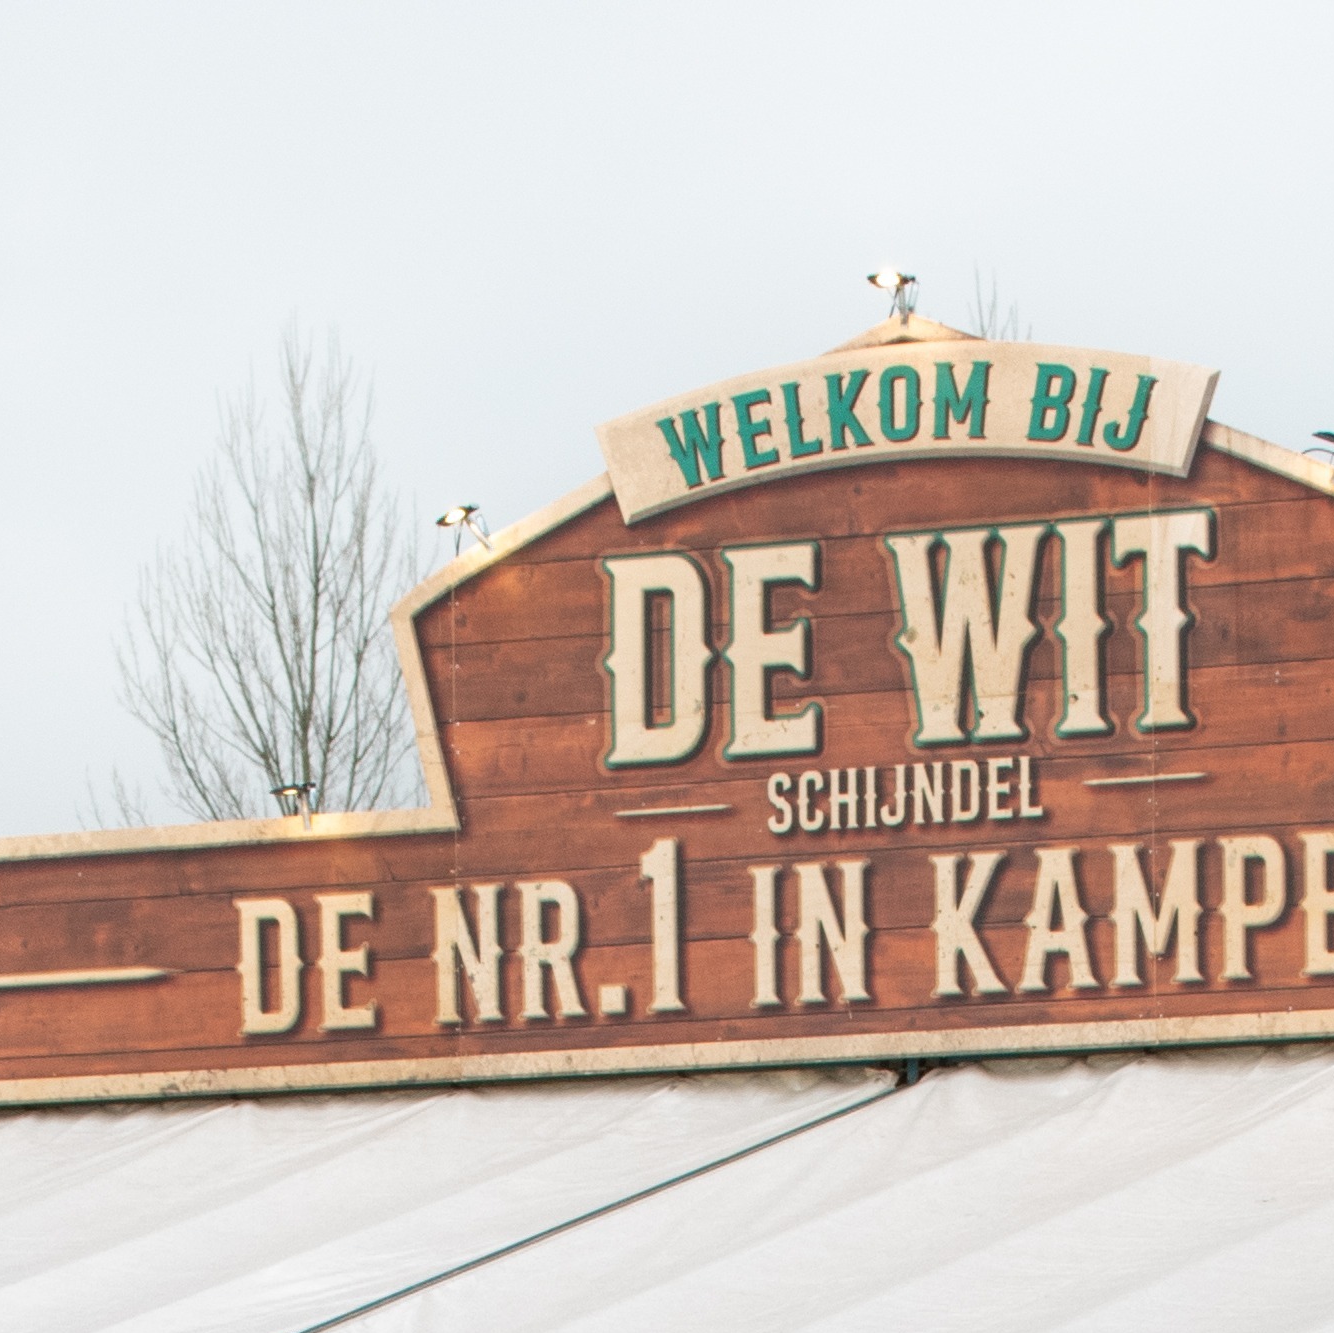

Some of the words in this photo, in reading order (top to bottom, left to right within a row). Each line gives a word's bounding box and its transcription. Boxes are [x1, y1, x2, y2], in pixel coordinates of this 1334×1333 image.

[656, 361, 992, 489] WELKOM
[1026, 362, 1158, 452] BIJ
[602, 540, 824, 770] DE
[886, 507, 1219, 747] WIT
[767, 756, 1044, 834] SCHIJNDEL
[233, 891, 377, 1037] DE
[430, 838, 685, 1025] NR.1
[747, 857, 870, 1008] IN
